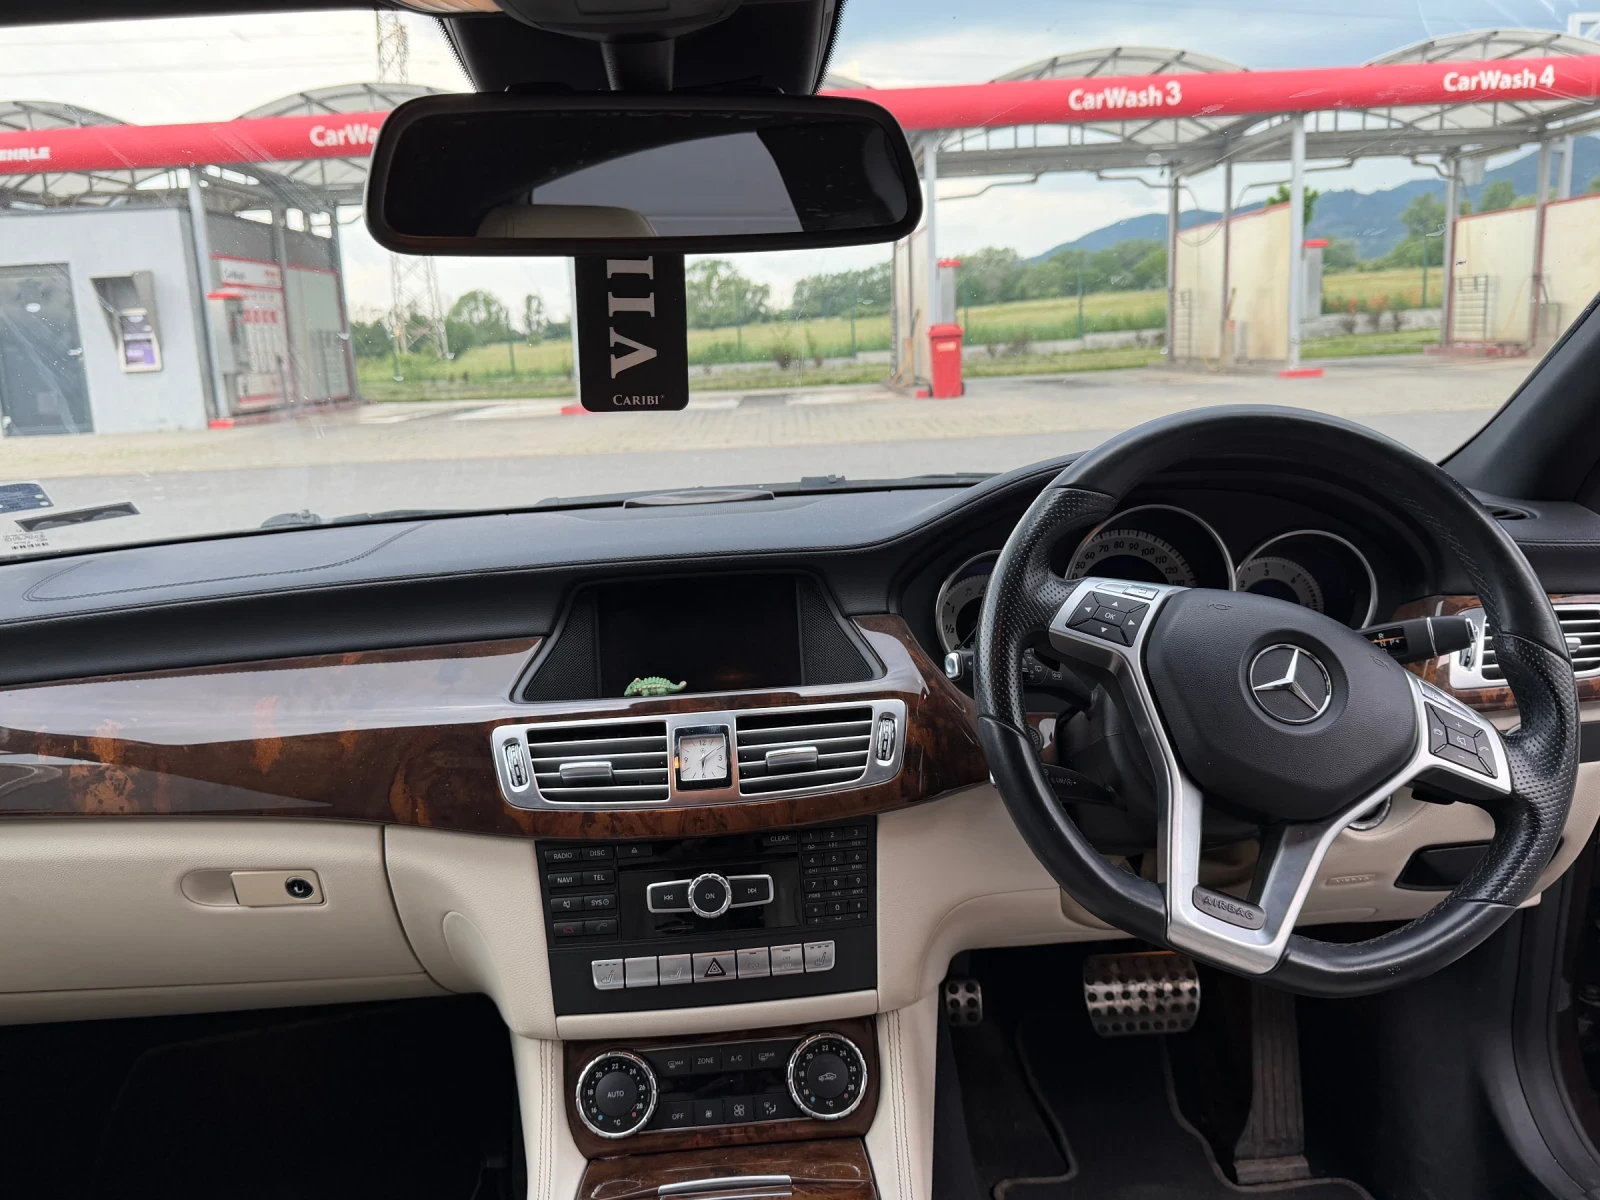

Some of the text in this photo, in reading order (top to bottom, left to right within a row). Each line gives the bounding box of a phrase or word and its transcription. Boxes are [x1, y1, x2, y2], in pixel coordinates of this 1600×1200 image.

[1443, 64, 1555, 92] CarWash 4
[1068, 80, 1183, 111] CarWash 3
[1099, 544, 1109, 553] 70
[1114, 541, 1124, 549] 80
[1128, 542, 1139, 551] 90
[1084, 551, 1096, 560] 60
[1141, 547, 1155, 556] 100
[1155, 555, 1167, 564] 110
[1075, 561, 1086, 570] 50
[1164, 566, 1178, 575] 120
[1264, 569, 1270, 577] 3
[1240, 580, 1246, 588] 2
[1104, 612, 1116, 620] OK
[770, 834, 790, 842] CLEAR
[589, 849, 606, 857] DISC
[705, 892, 715, 900] ON
[1202, 896, 1254, 920] AIRBAG
[697, 1056, 714, 1065] ZONE
[730, 1054, 743, 1063] A/C
[611, 1062, 619, 1070] 22
[849, 1065, 857, 1073] 26
[587, 1088, 594, 1096] 18
[607, 1090, 625, 1098] AUTO
[671, 1112, 685, 1120] OFF
